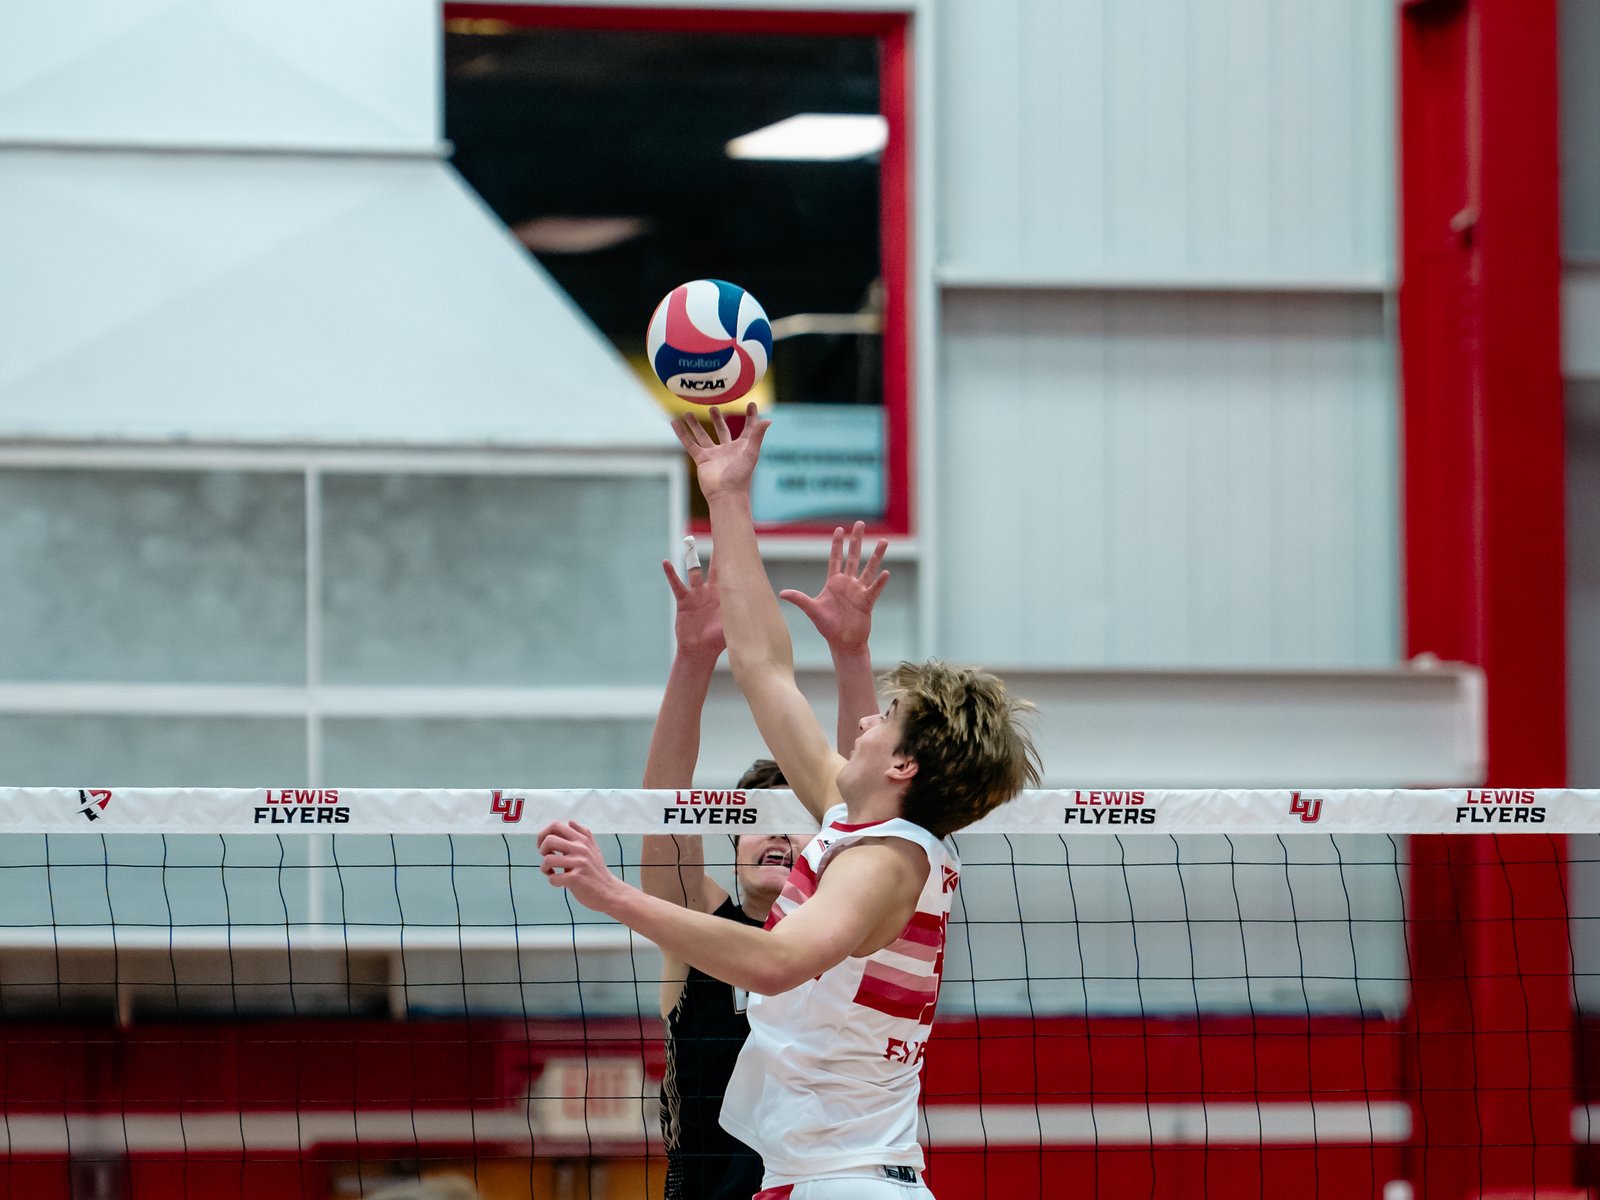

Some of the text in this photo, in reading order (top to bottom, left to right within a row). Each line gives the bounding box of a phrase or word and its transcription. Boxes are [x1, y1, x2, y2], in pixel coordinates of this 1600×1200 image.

[678, 358, 721, 368] molten
[680, 378, 726, 390] NCAA
[265, 789, 339, 805] LEWIS
[675, 790, 747, 805] LEWIS
[1075, 790, 1145, 806] LEWIS
[1466, 789, 1536, 805] LEWIS
[489, 789, 525, 823] LU
[1289, 790, 1324, 824] LU
[253, 807, 350, 824] FLYERS
[663, 807, 758, 825] FLYERS
[1064, 808, 1157, 825] FLYERS
[1455, 807, 1547, 824] FLYERS
